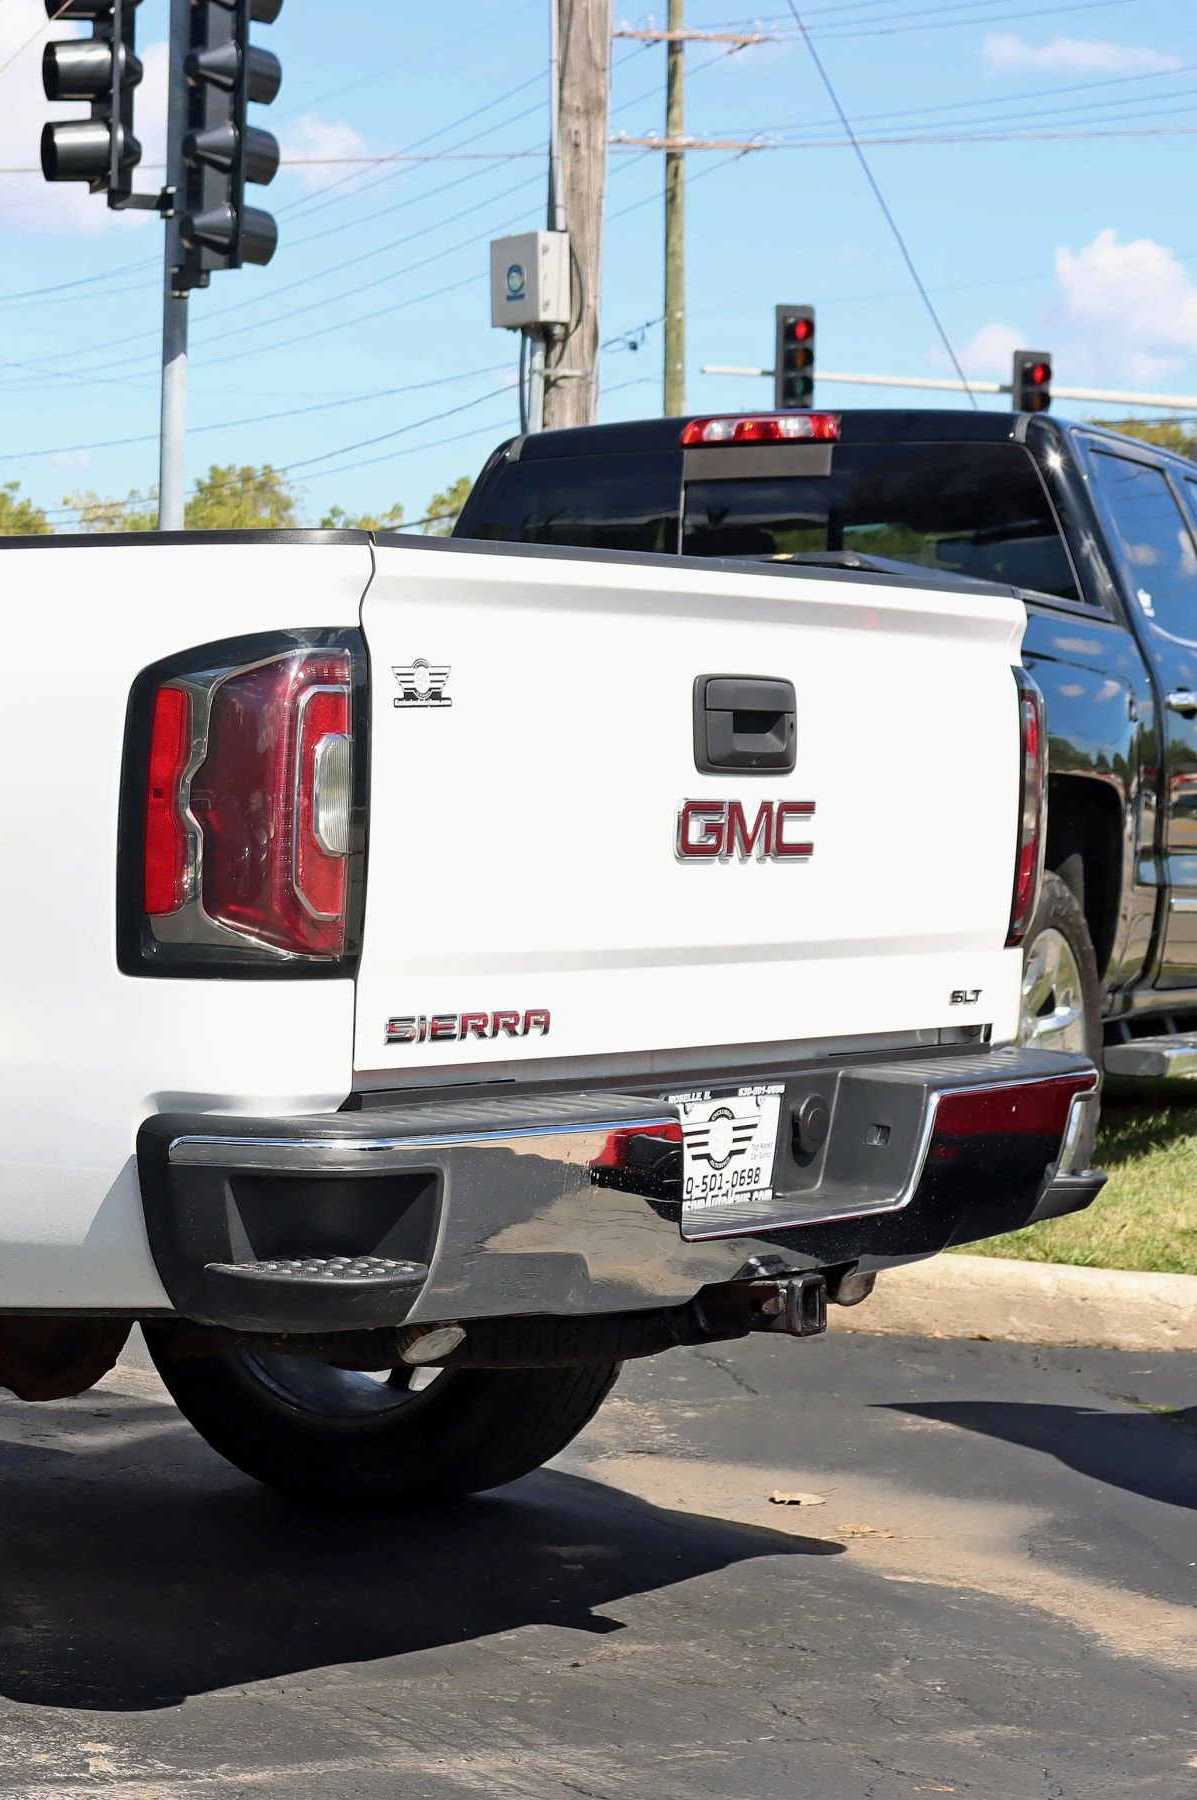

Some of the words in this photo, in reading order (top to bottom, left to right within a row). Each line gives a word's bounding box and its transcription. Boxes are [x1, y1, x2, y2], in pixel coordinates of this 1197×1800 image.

[674, 798, 816, 864] GMC
[949, 989, 983, 1005] SLT
[384, 1008, 551, 1045] SIERRA
[703, 1091, 712, 1101] IL
